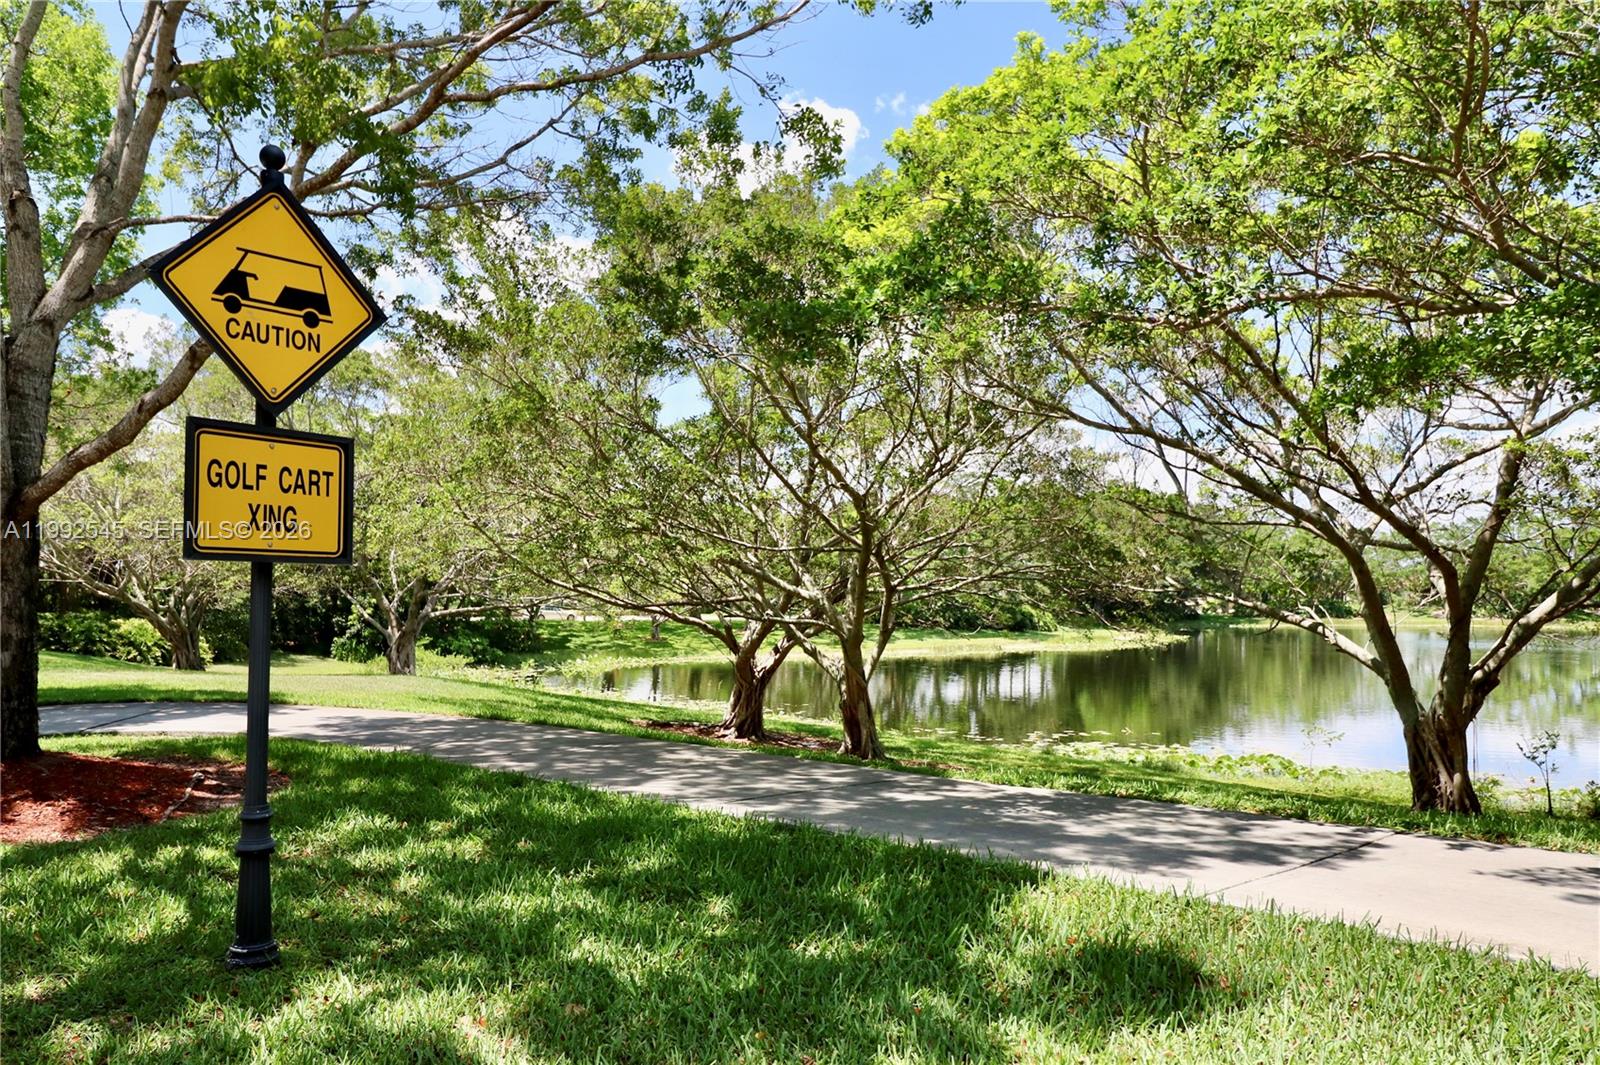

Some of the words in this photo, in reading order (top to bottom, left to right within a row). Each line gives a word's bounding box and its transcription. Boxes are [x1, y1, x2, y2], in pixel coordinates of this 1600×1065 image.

[225, 318, 321, 353] CAUTION
[207, 458, 268, 491] GOLF
[278, 466, 334, 497] CART
[247, 503, 298, 533] XING
